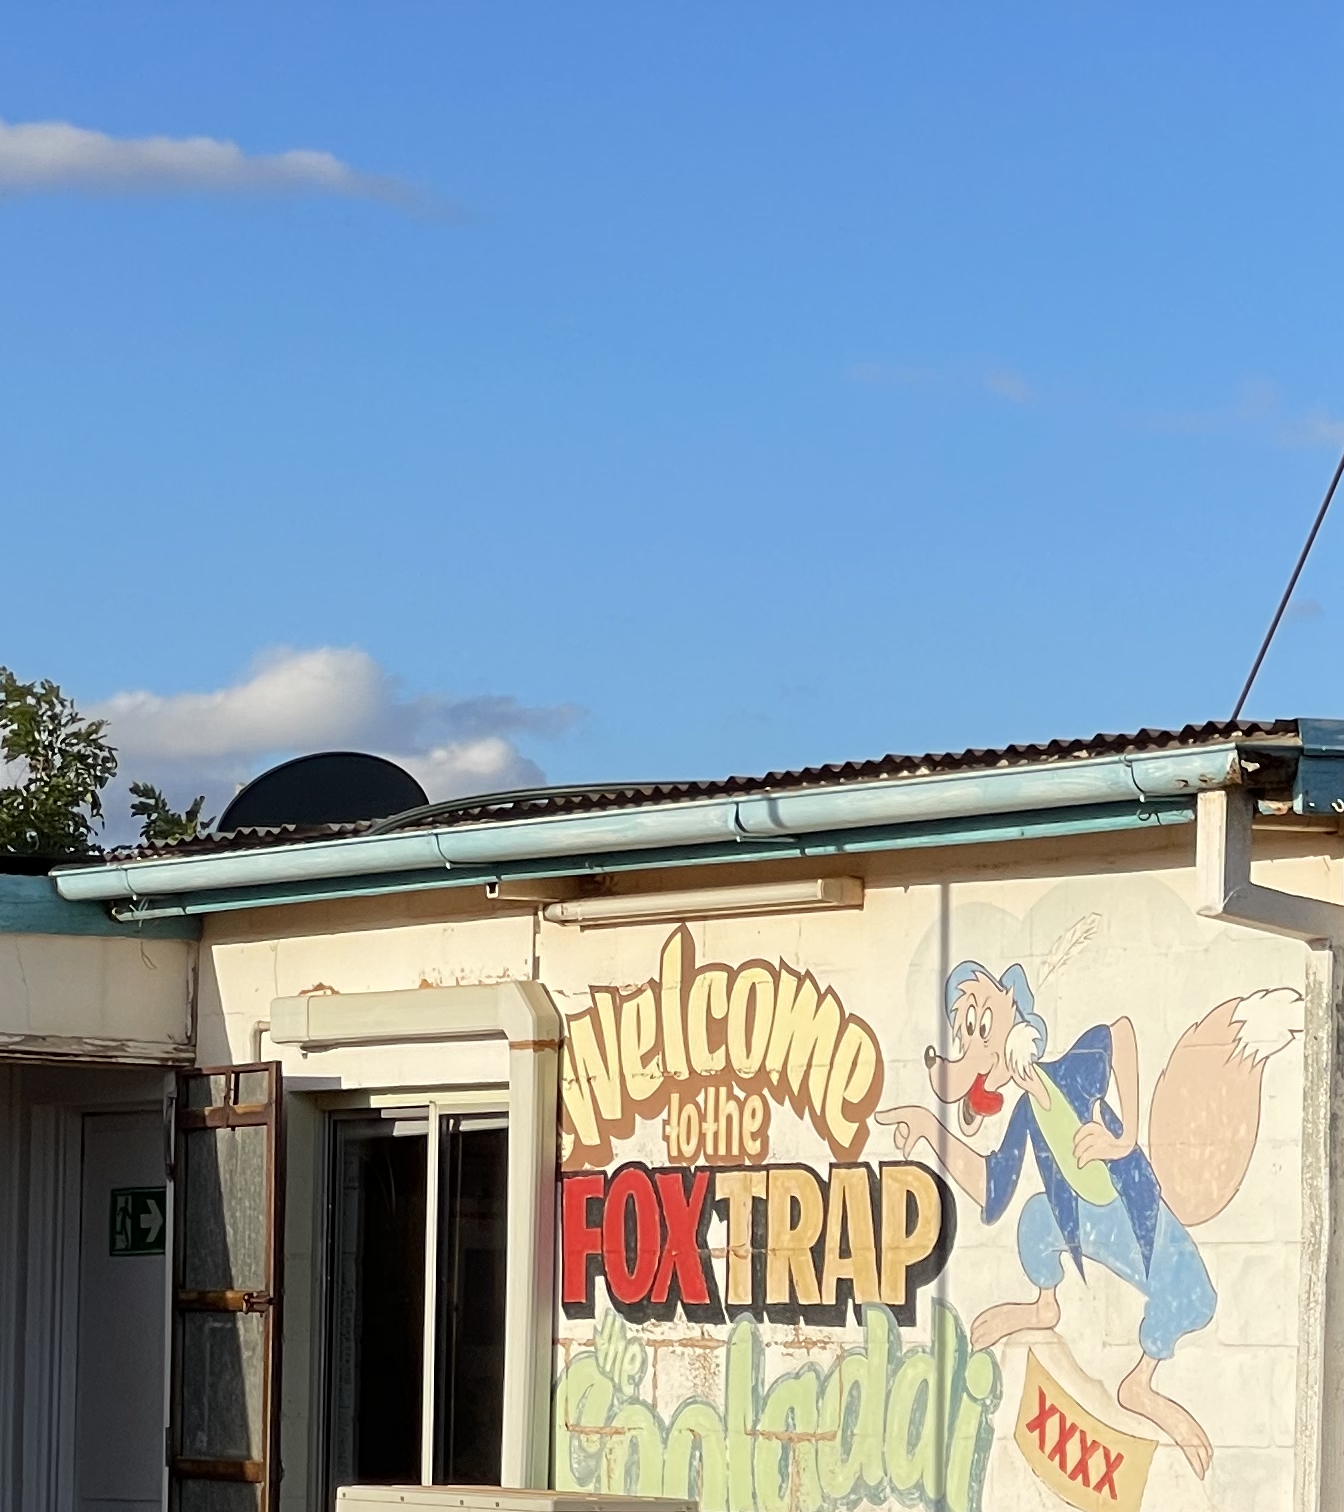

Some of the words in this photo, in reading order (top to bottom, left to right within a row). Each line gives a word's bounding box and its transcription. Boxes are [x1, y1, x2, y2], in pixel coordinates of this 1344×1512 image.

[562, 926, 884, 1165] Welcome
[595, 1308, 648, 1399] the
[1025, 1386, 1124, 1500] XXXX
